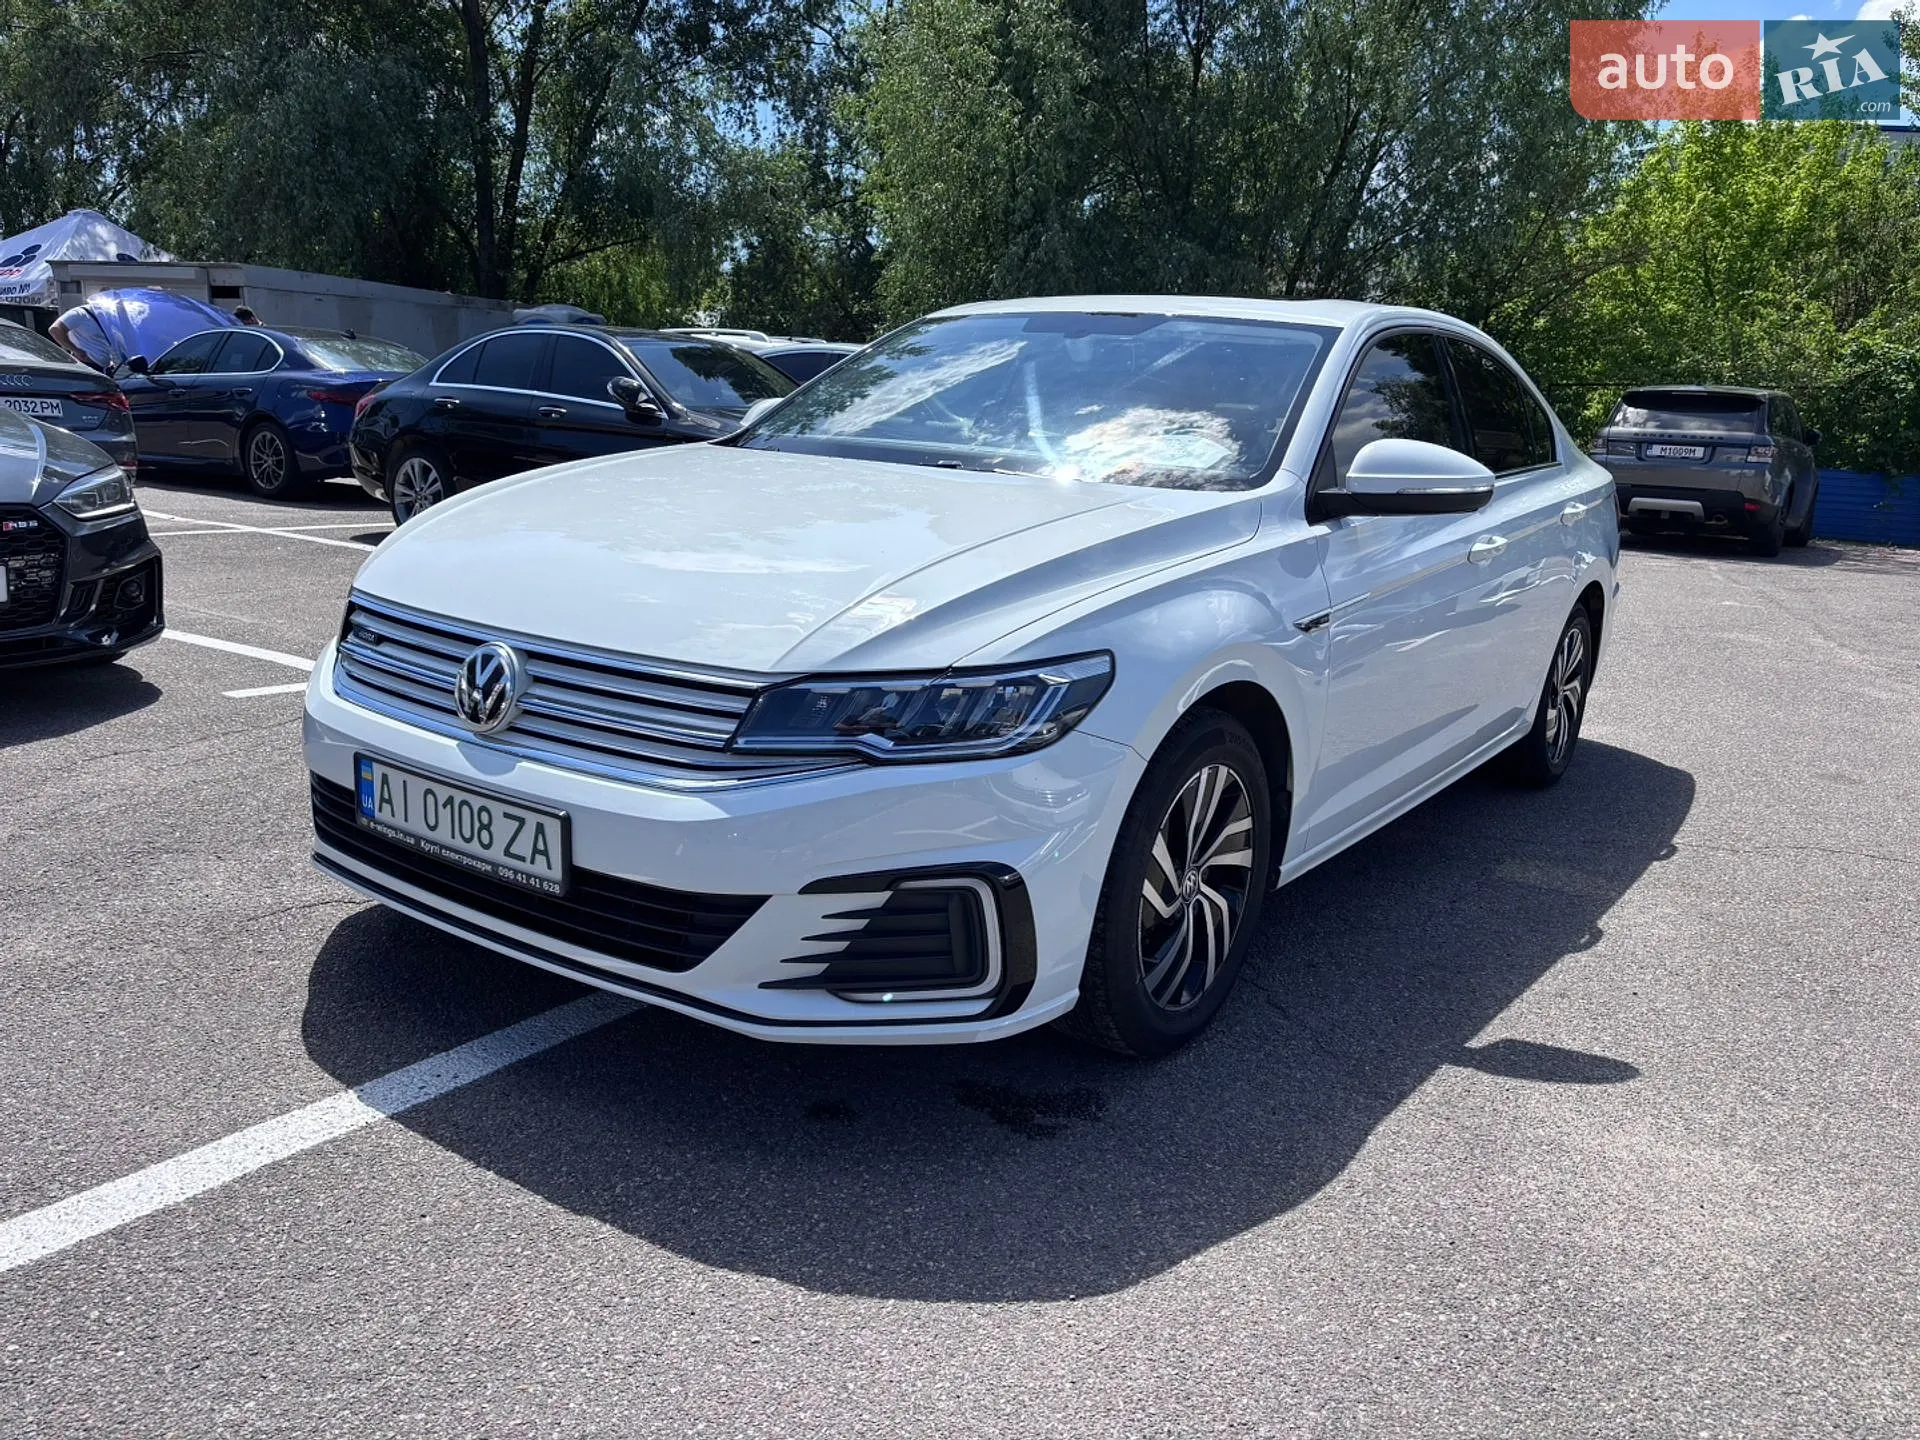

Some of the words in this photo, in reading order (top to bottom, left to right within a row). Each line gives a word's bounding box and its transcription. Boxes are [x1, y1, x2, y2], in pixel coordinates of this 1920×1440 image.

[361, 793, 375, 809] UA
[378, 772, 409, 823] AI
[423, 788, 494, 851] 0108
[503, 811, 553, 871] ZA
